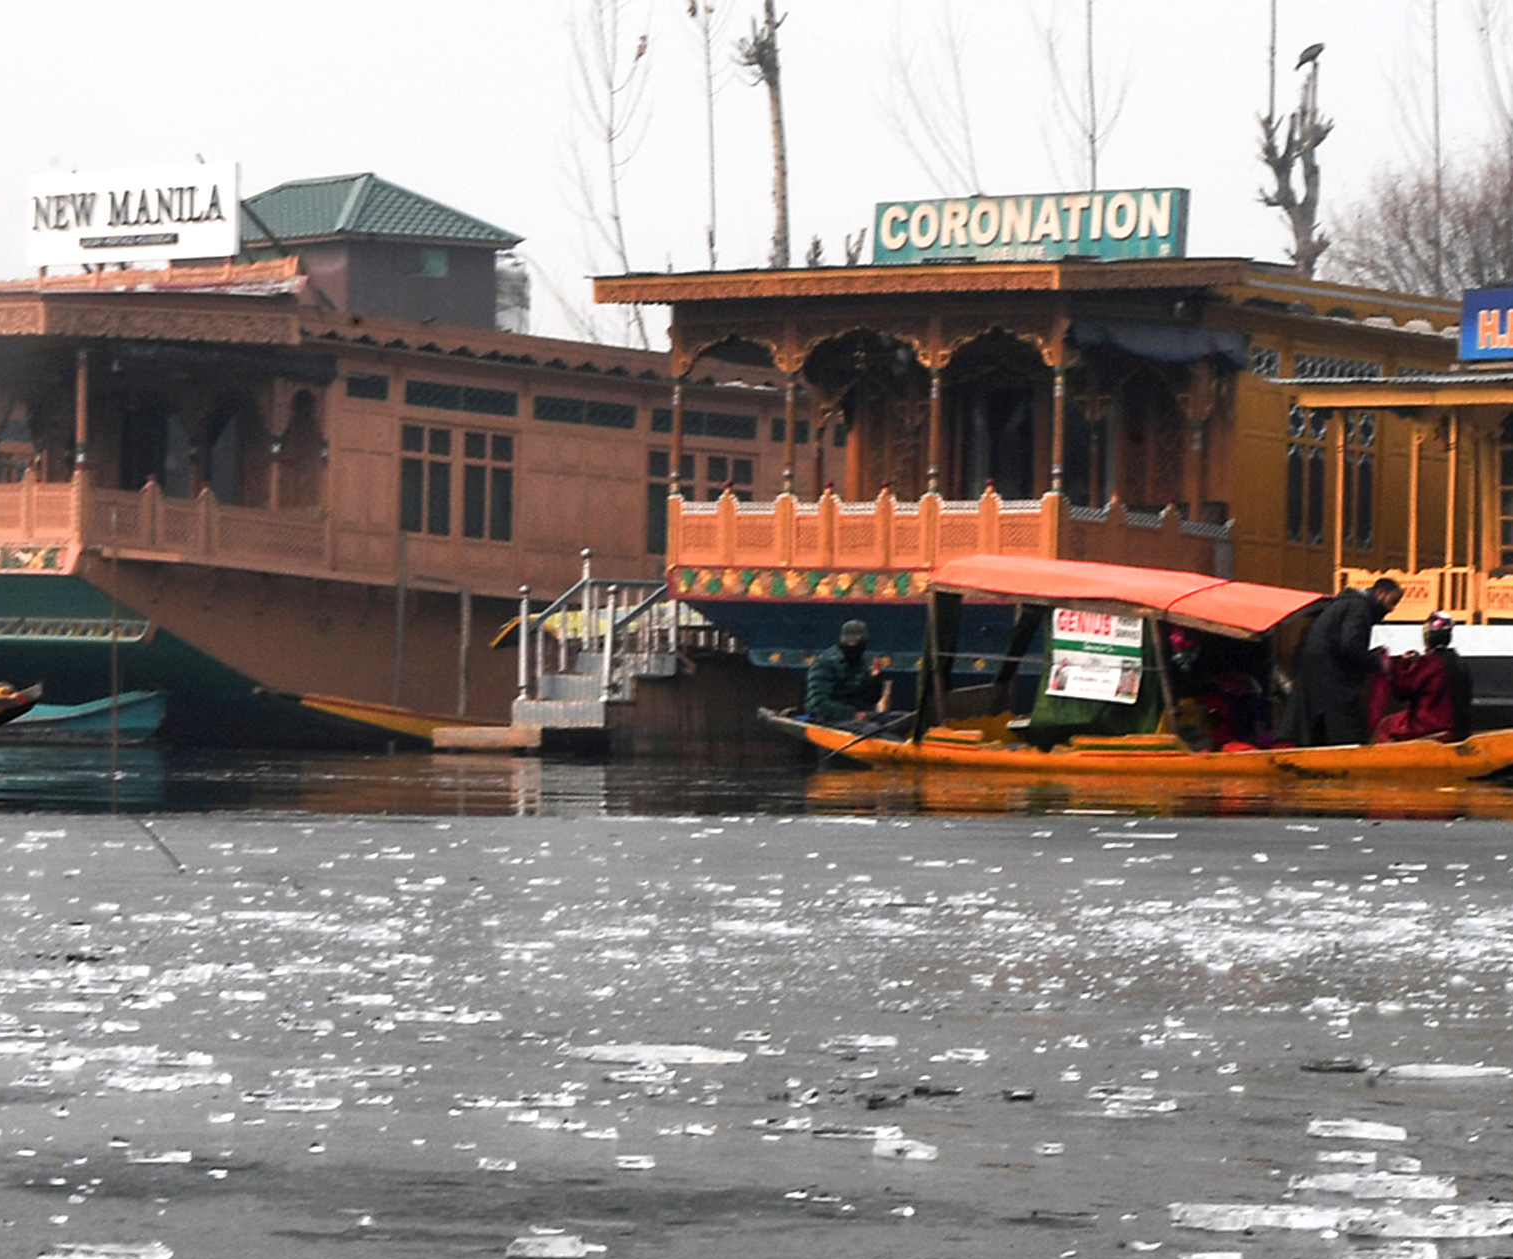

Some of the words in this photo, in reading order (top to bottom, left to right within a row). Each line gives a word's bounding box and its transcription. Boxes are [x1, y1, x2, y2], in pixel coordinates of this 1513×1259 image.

[32, 192, 99, 231] NEW
[107, 184, 227, 227] MANILA
[880, 191, 1172, 251] CORONATION
[1058, 610, 1112, 636] GENIUS
